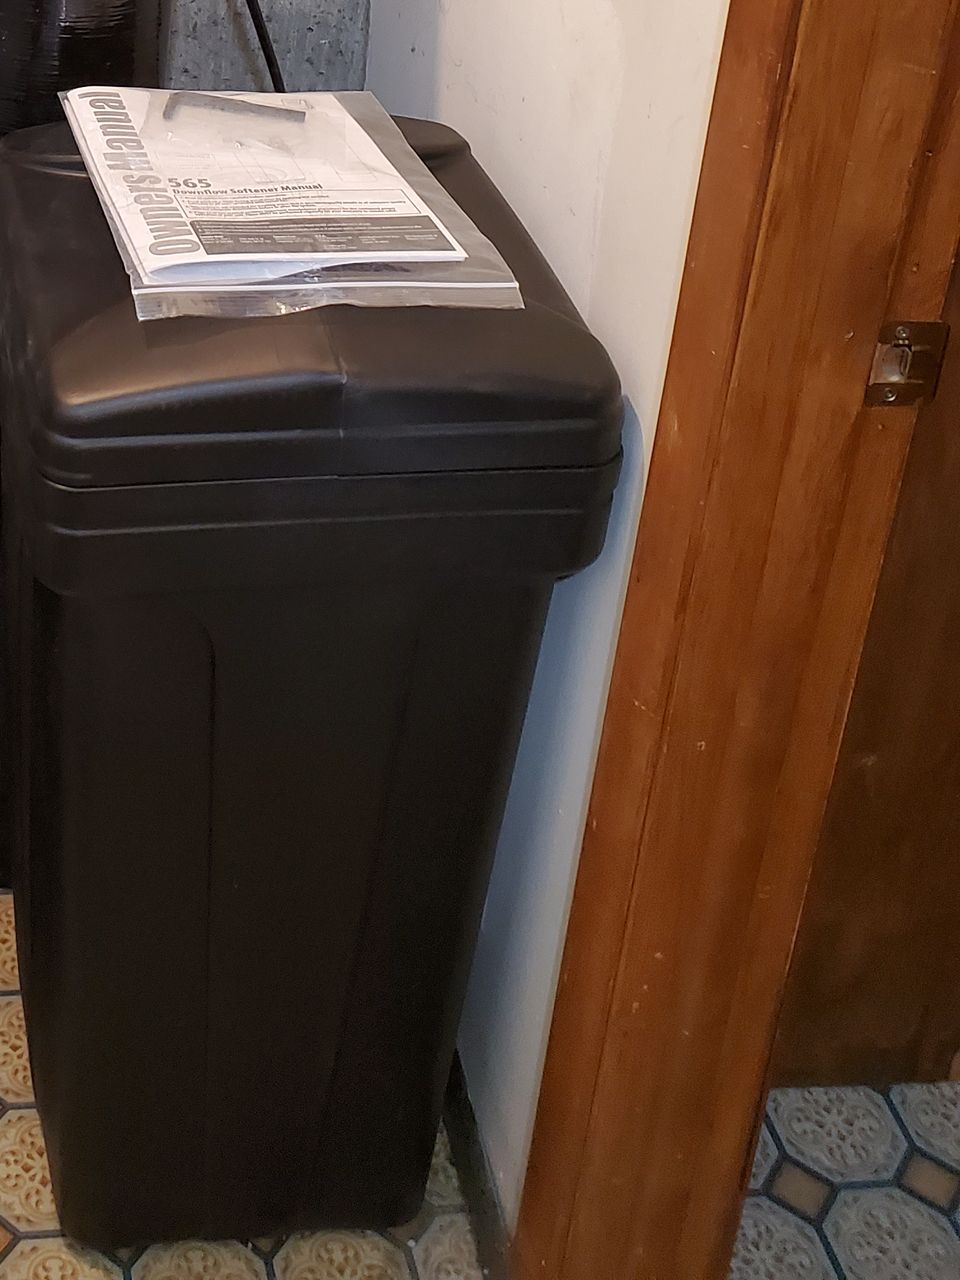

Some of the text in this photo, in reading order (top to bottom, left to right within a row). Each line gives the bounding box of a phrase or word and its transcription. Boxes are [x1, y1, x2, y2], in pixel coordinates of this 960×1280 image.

[78, 91, 154, 170] Manual
[168, 177, 212, 189] 565
[172, 188, 228, 196] Downflow
[230, 186, 279, 195] Softener
[280, 183, 324, 192] Manual
